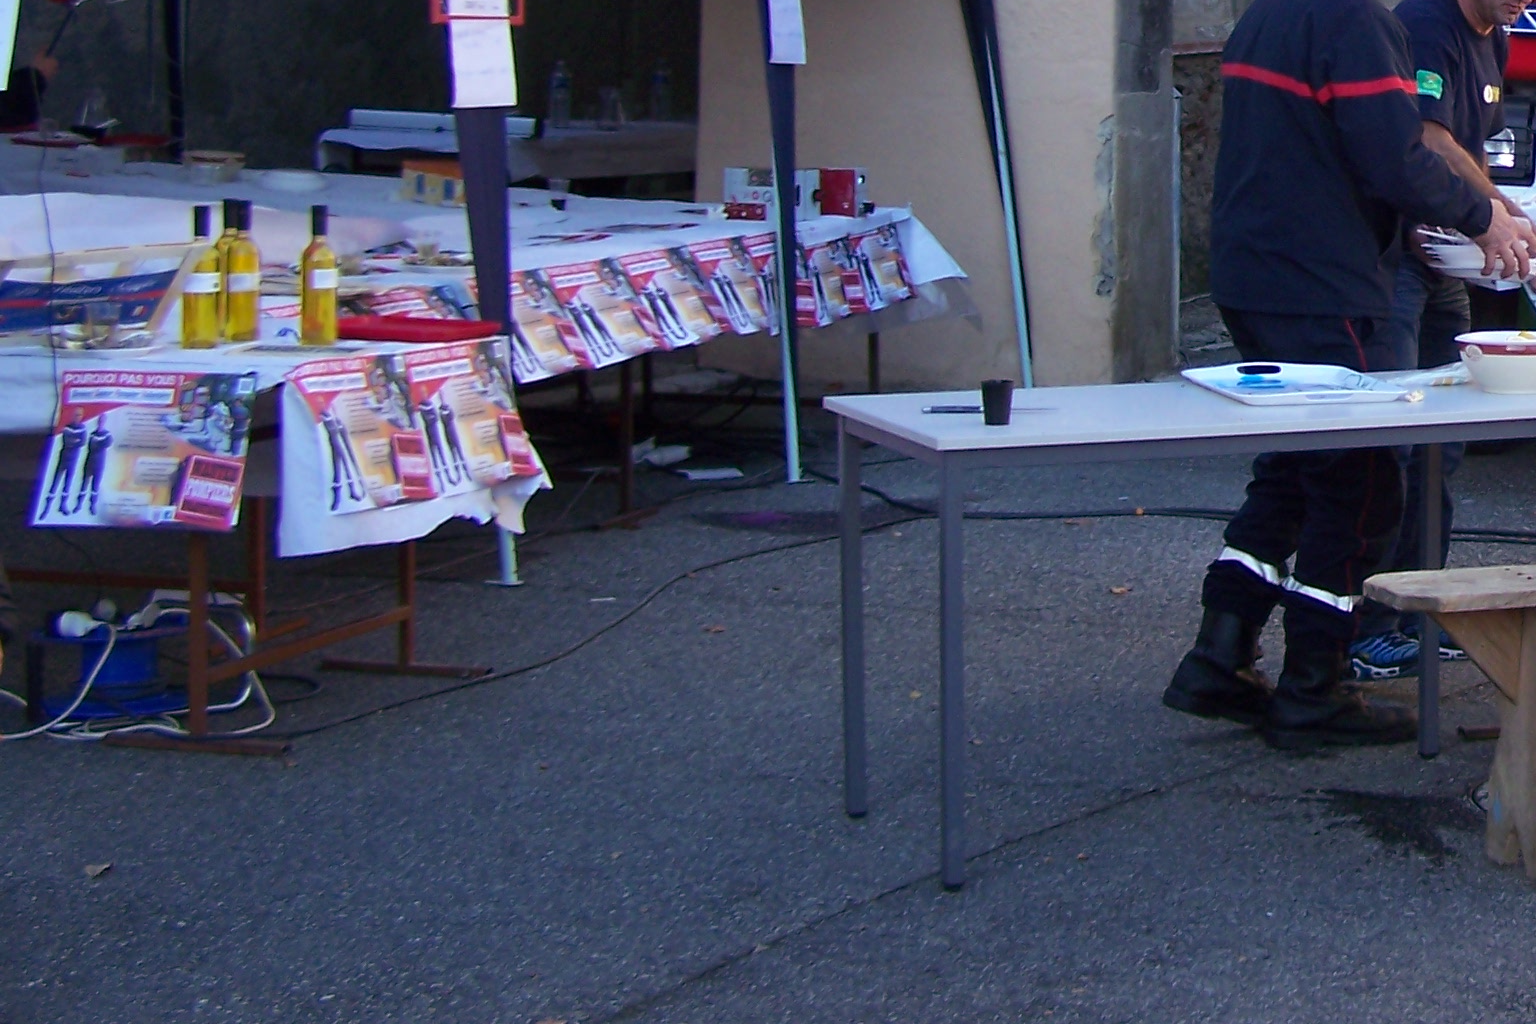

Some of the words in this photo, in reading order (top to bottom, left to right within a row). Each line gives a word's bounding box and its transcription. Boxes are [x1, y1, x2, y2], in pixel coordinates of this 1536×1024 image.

[64, 373, 117, 385] POURQUOI
[119, 374, 144, 385] PAS
[146, 375, 177, 385] VOUS
